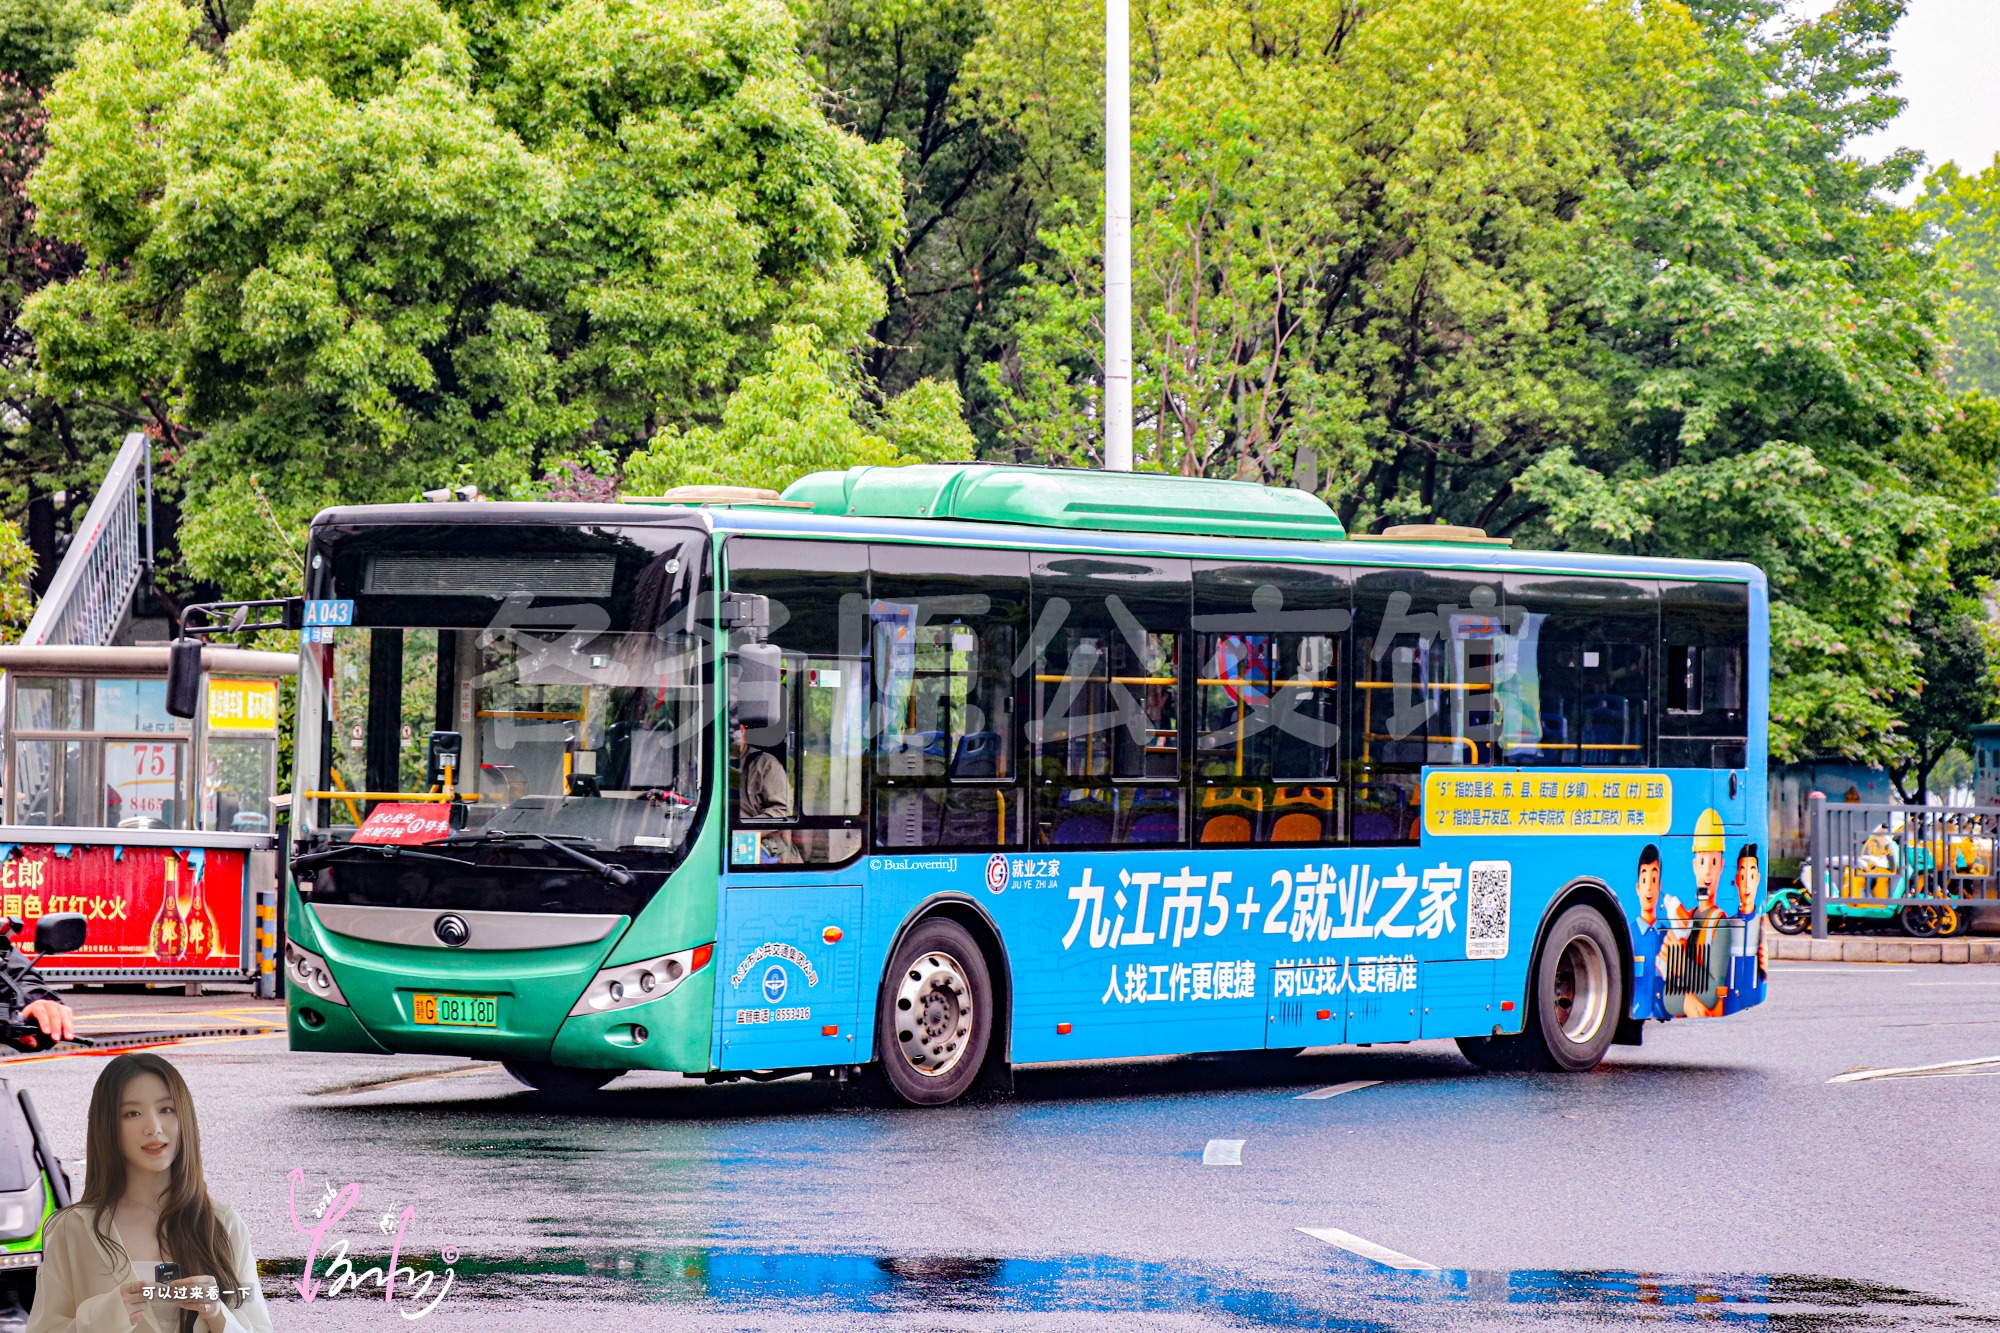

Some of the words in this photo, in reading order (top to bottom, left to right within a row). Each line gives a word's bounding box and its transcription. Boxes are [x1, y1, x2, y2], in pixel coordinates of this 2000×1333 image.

[306, 603, 317, 623] A
[320, 603, 349, 623] 043
[1011, 859, 1060, 878] 就业之家
[1062, 862, 1463, 951] 九江市5+2就业之家
[1102, 959, 1256, 1004] 人找工作更便捷
[1274, 953, 1418, 998] 岗位找人更精准
